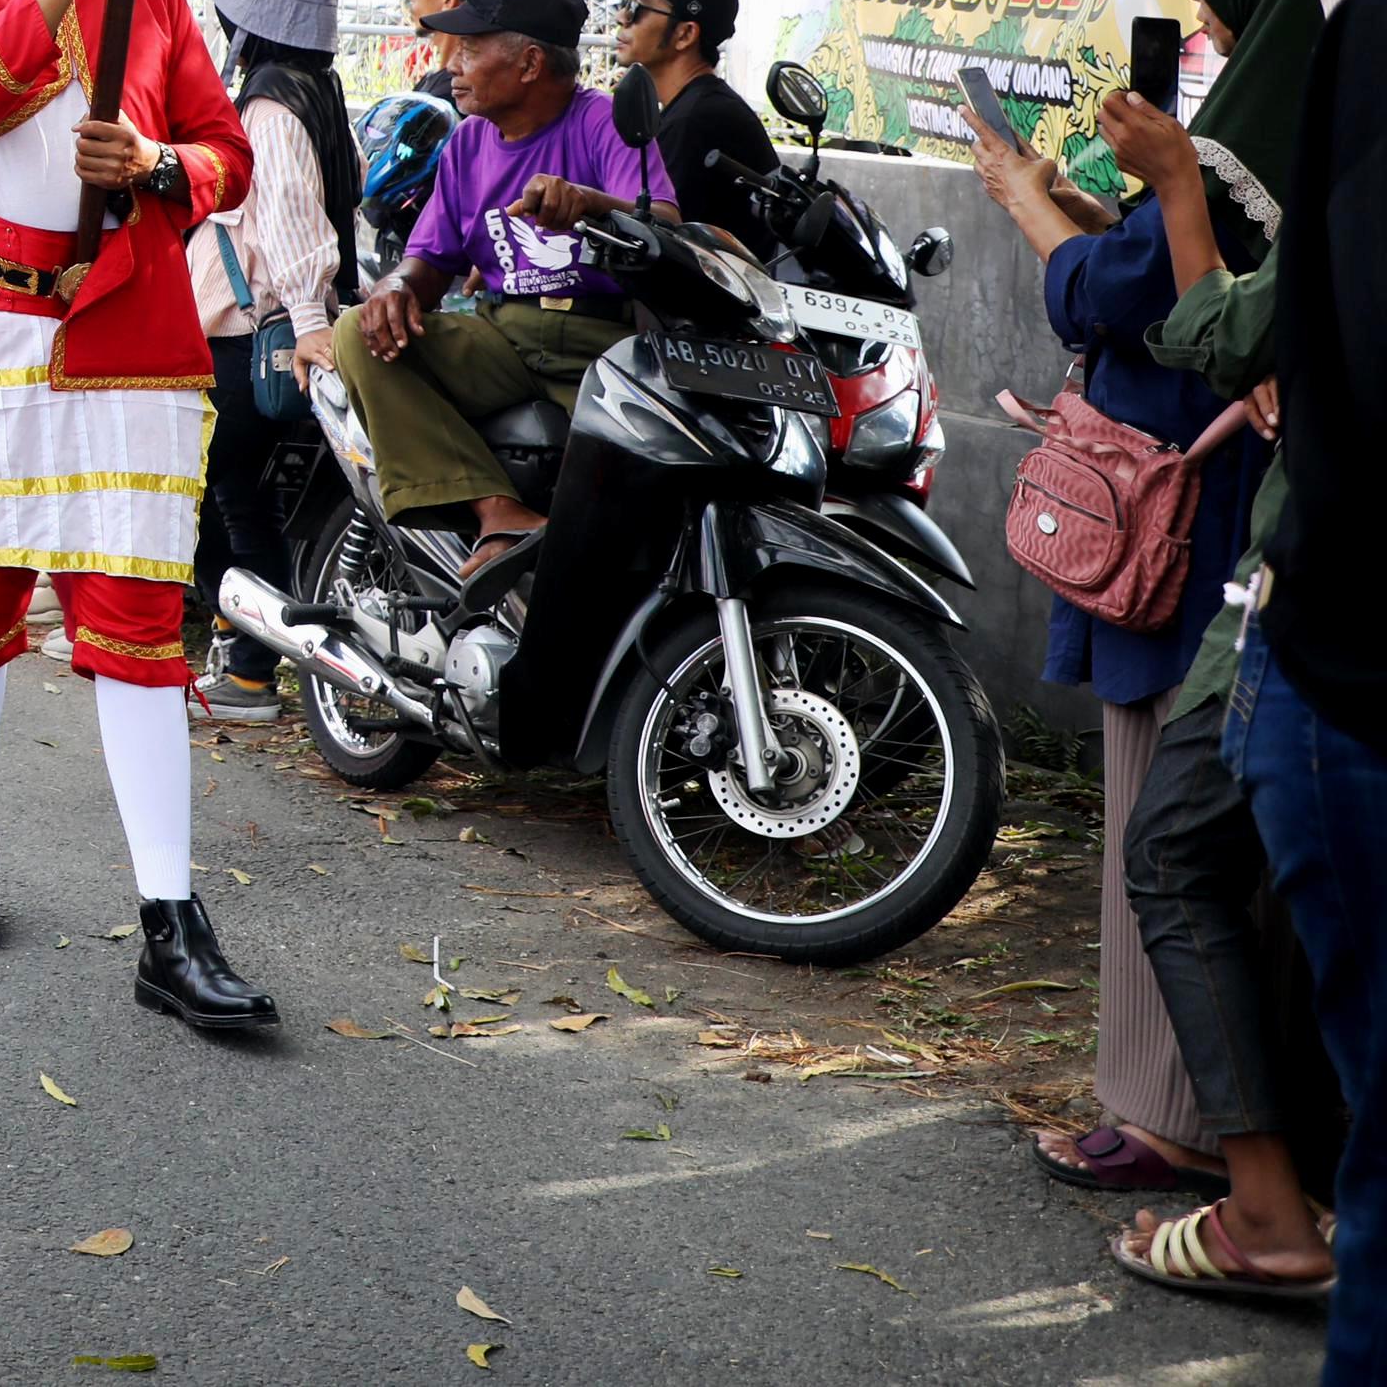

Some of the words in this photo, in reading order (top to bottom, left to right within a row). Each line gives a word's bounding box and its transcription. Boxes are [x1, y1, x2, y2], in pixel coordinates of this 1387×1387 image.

[1012, 61, 1071, 102] UNDANG
[804, 291, 863, 316] 6394
[665, 338, 695, 363] AB
[705, 345, 770, 373] 5020
